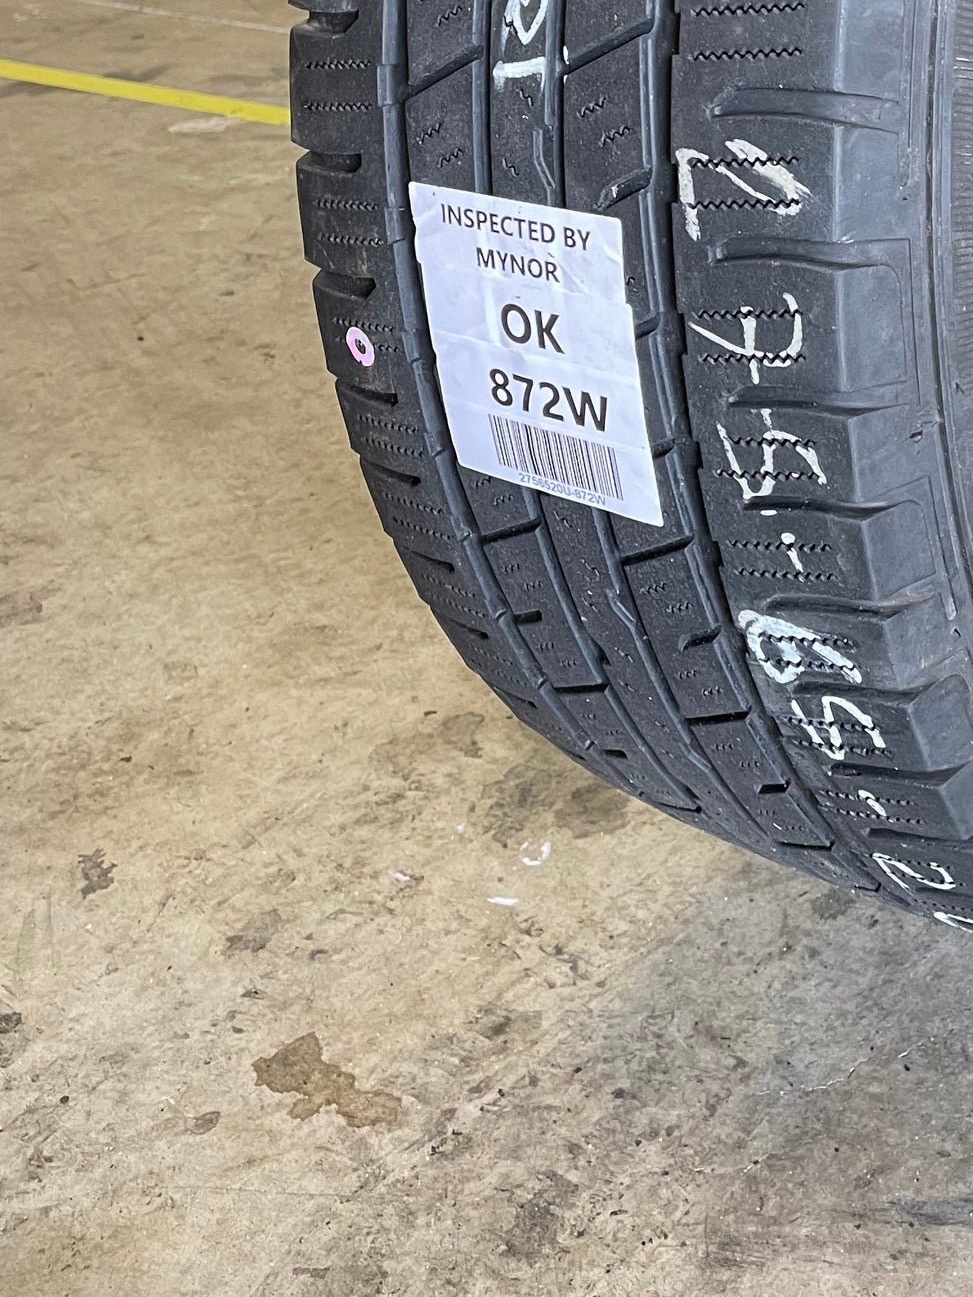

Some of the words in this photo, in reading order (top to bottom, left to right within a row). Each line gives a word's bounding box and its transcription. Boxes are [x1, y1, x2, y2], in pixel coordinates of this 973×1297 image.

[440, 203, 556, 244] INSPECTED
[562, 225, 592, 252] BY
[475, 246, 561, 283] MYNOR
[500, 302, 566, 355] OK
[488, 367, 608, 433] 872W
[518, 472, 607, 507] 2756520U-872W
